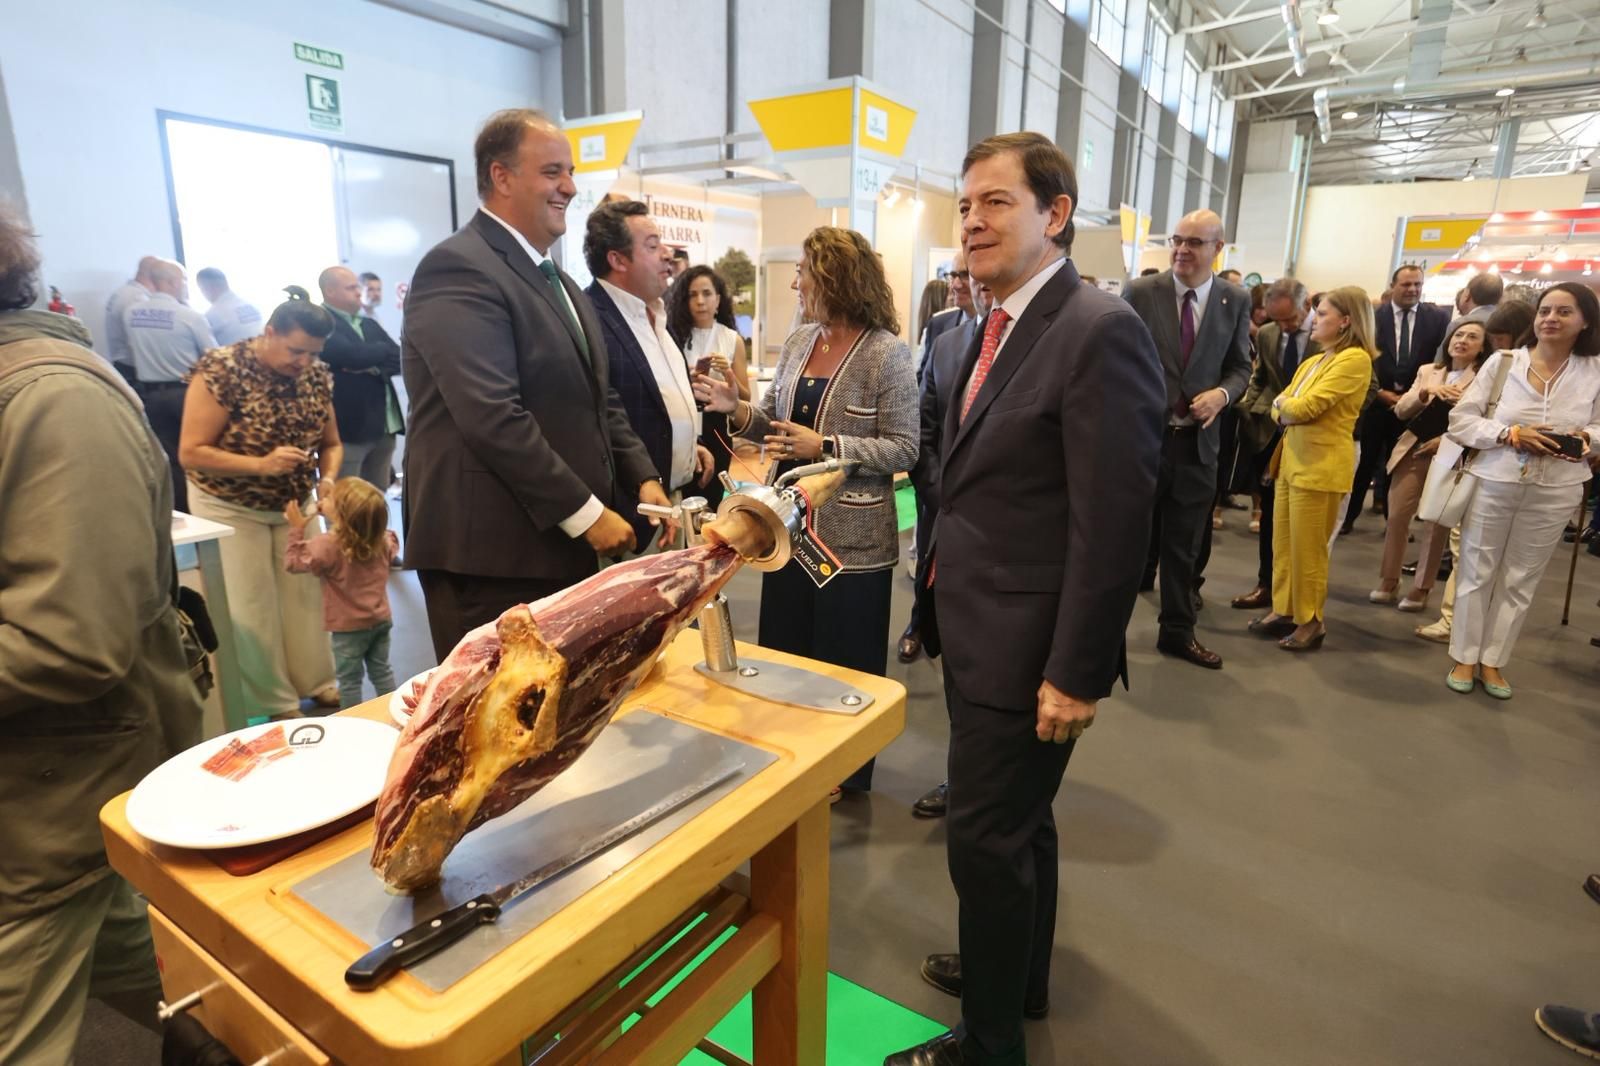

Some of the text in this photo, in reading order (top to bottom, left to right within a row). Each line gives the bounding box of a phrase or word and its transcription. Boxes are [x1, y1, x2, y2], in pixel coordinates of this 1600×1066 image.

[296, 46, 342, 67] SALIDA
[644, 194, 704, 222] TERNERA
[656, 222, 702, 244] HARRA
